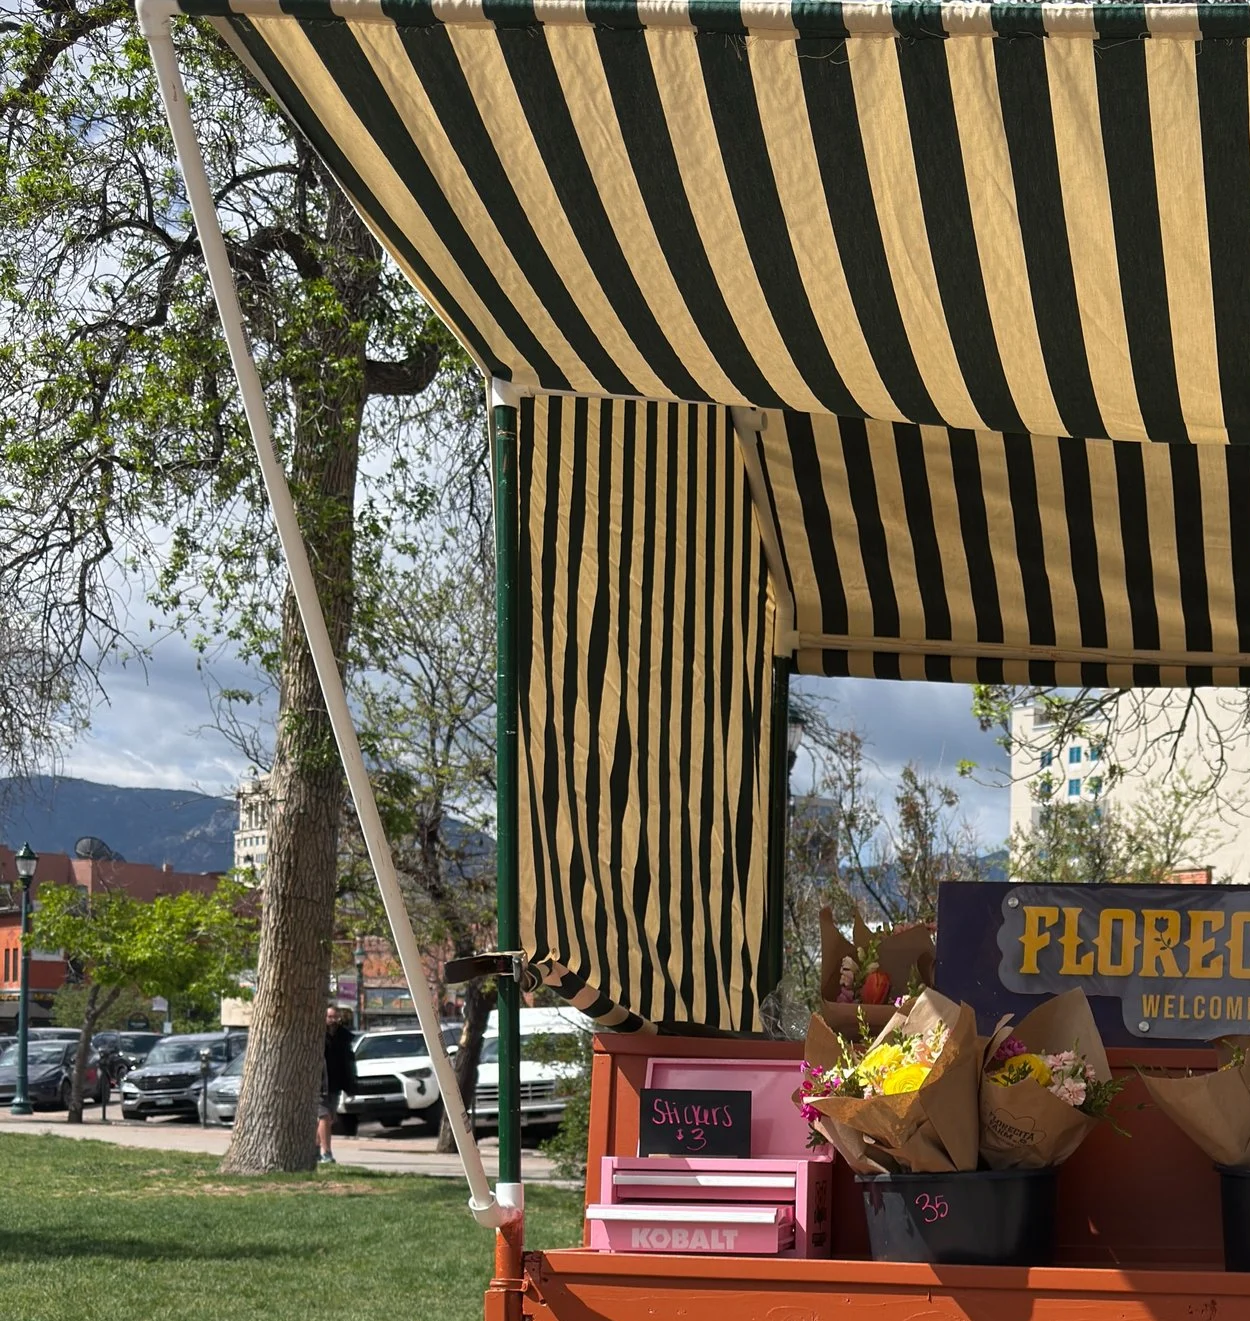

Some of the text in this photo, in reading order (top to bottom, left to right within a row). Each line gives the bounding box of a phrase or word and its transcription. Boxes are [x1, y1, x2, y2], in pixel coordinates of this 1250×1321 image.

[652, 1098, 733, 1128] Stickers
[915, 1193, 949, 1223] 35
[631, 1228, 739, 1250] KOBALT
